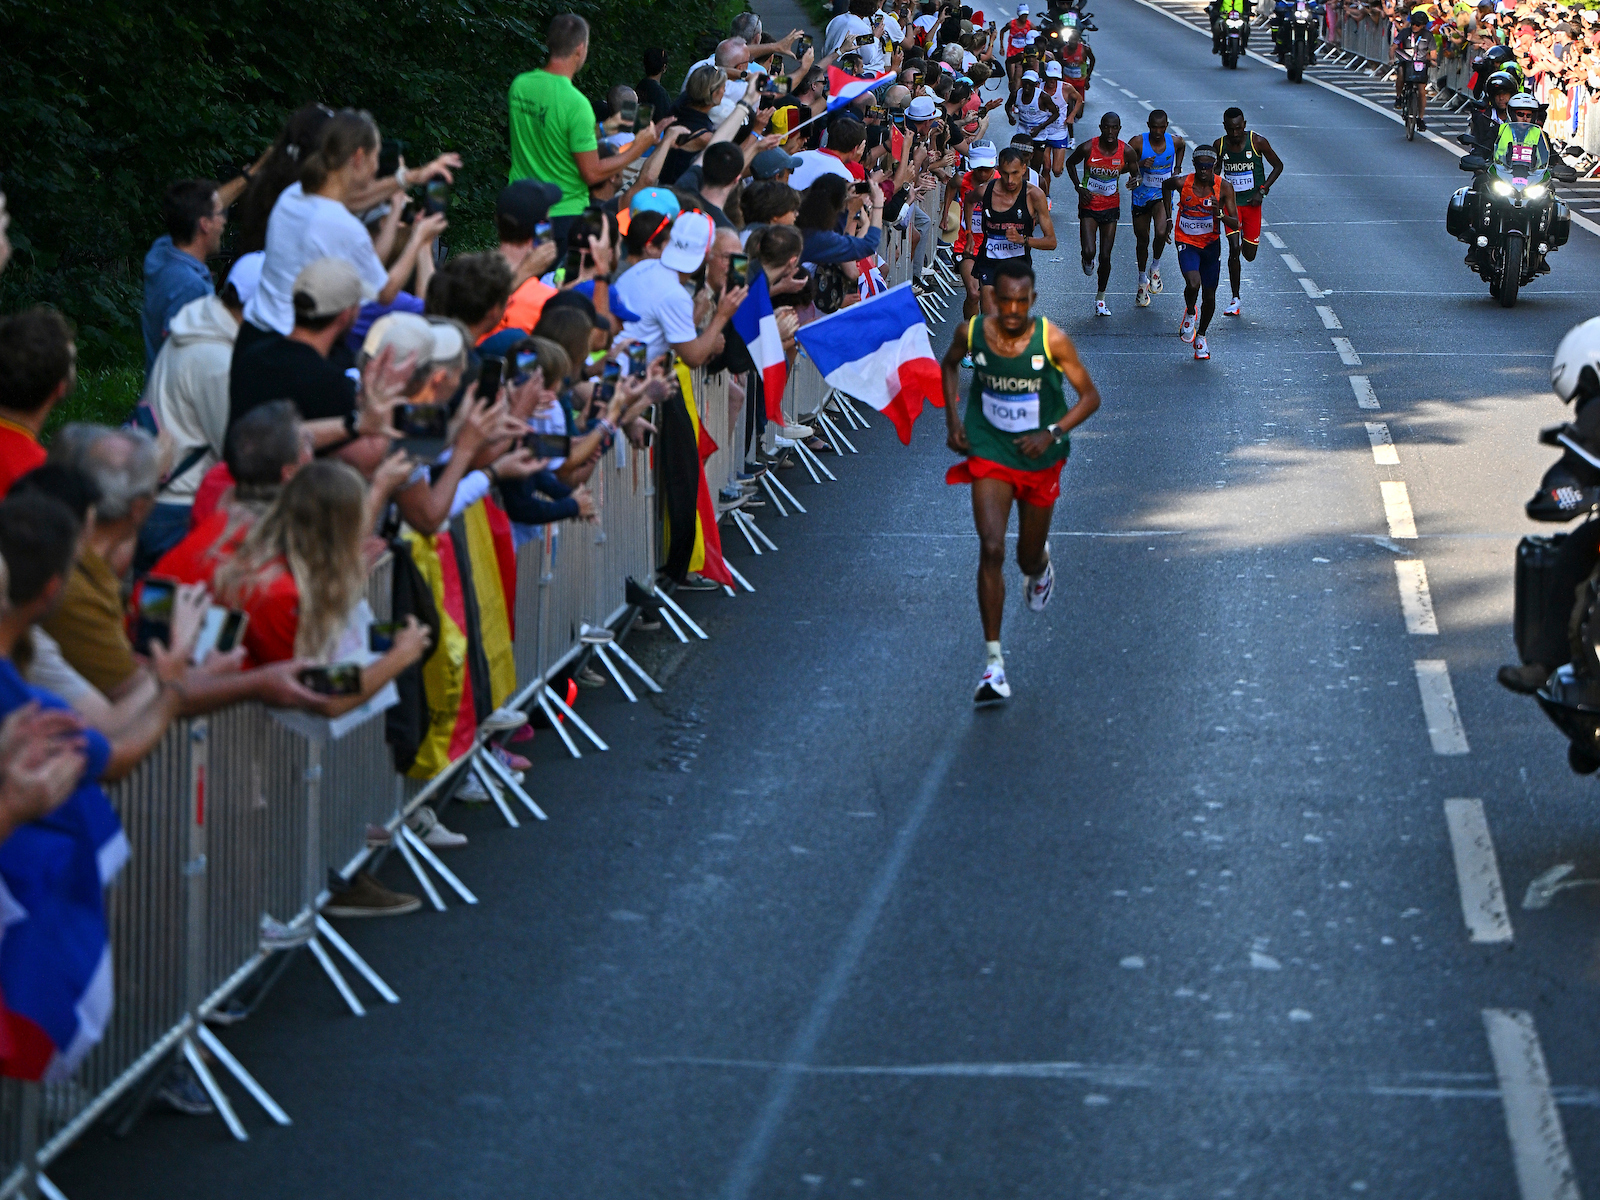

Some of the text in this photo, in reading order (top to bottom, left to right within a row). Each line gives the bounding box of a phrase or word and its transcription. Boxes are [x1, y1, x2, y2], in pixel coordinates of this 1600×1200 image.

[1225, 161, 1255, 171] ETHIOPIA
[1090, 167, 1119, 177] KENYA
[1088, 181, 1116, 191] KIPRUTO
[986, 243, 1024, 252] CAIRESS
[978, 371, 1042, 393] ETHIOPIA
[990, 403, 1027, 420] TOLA
